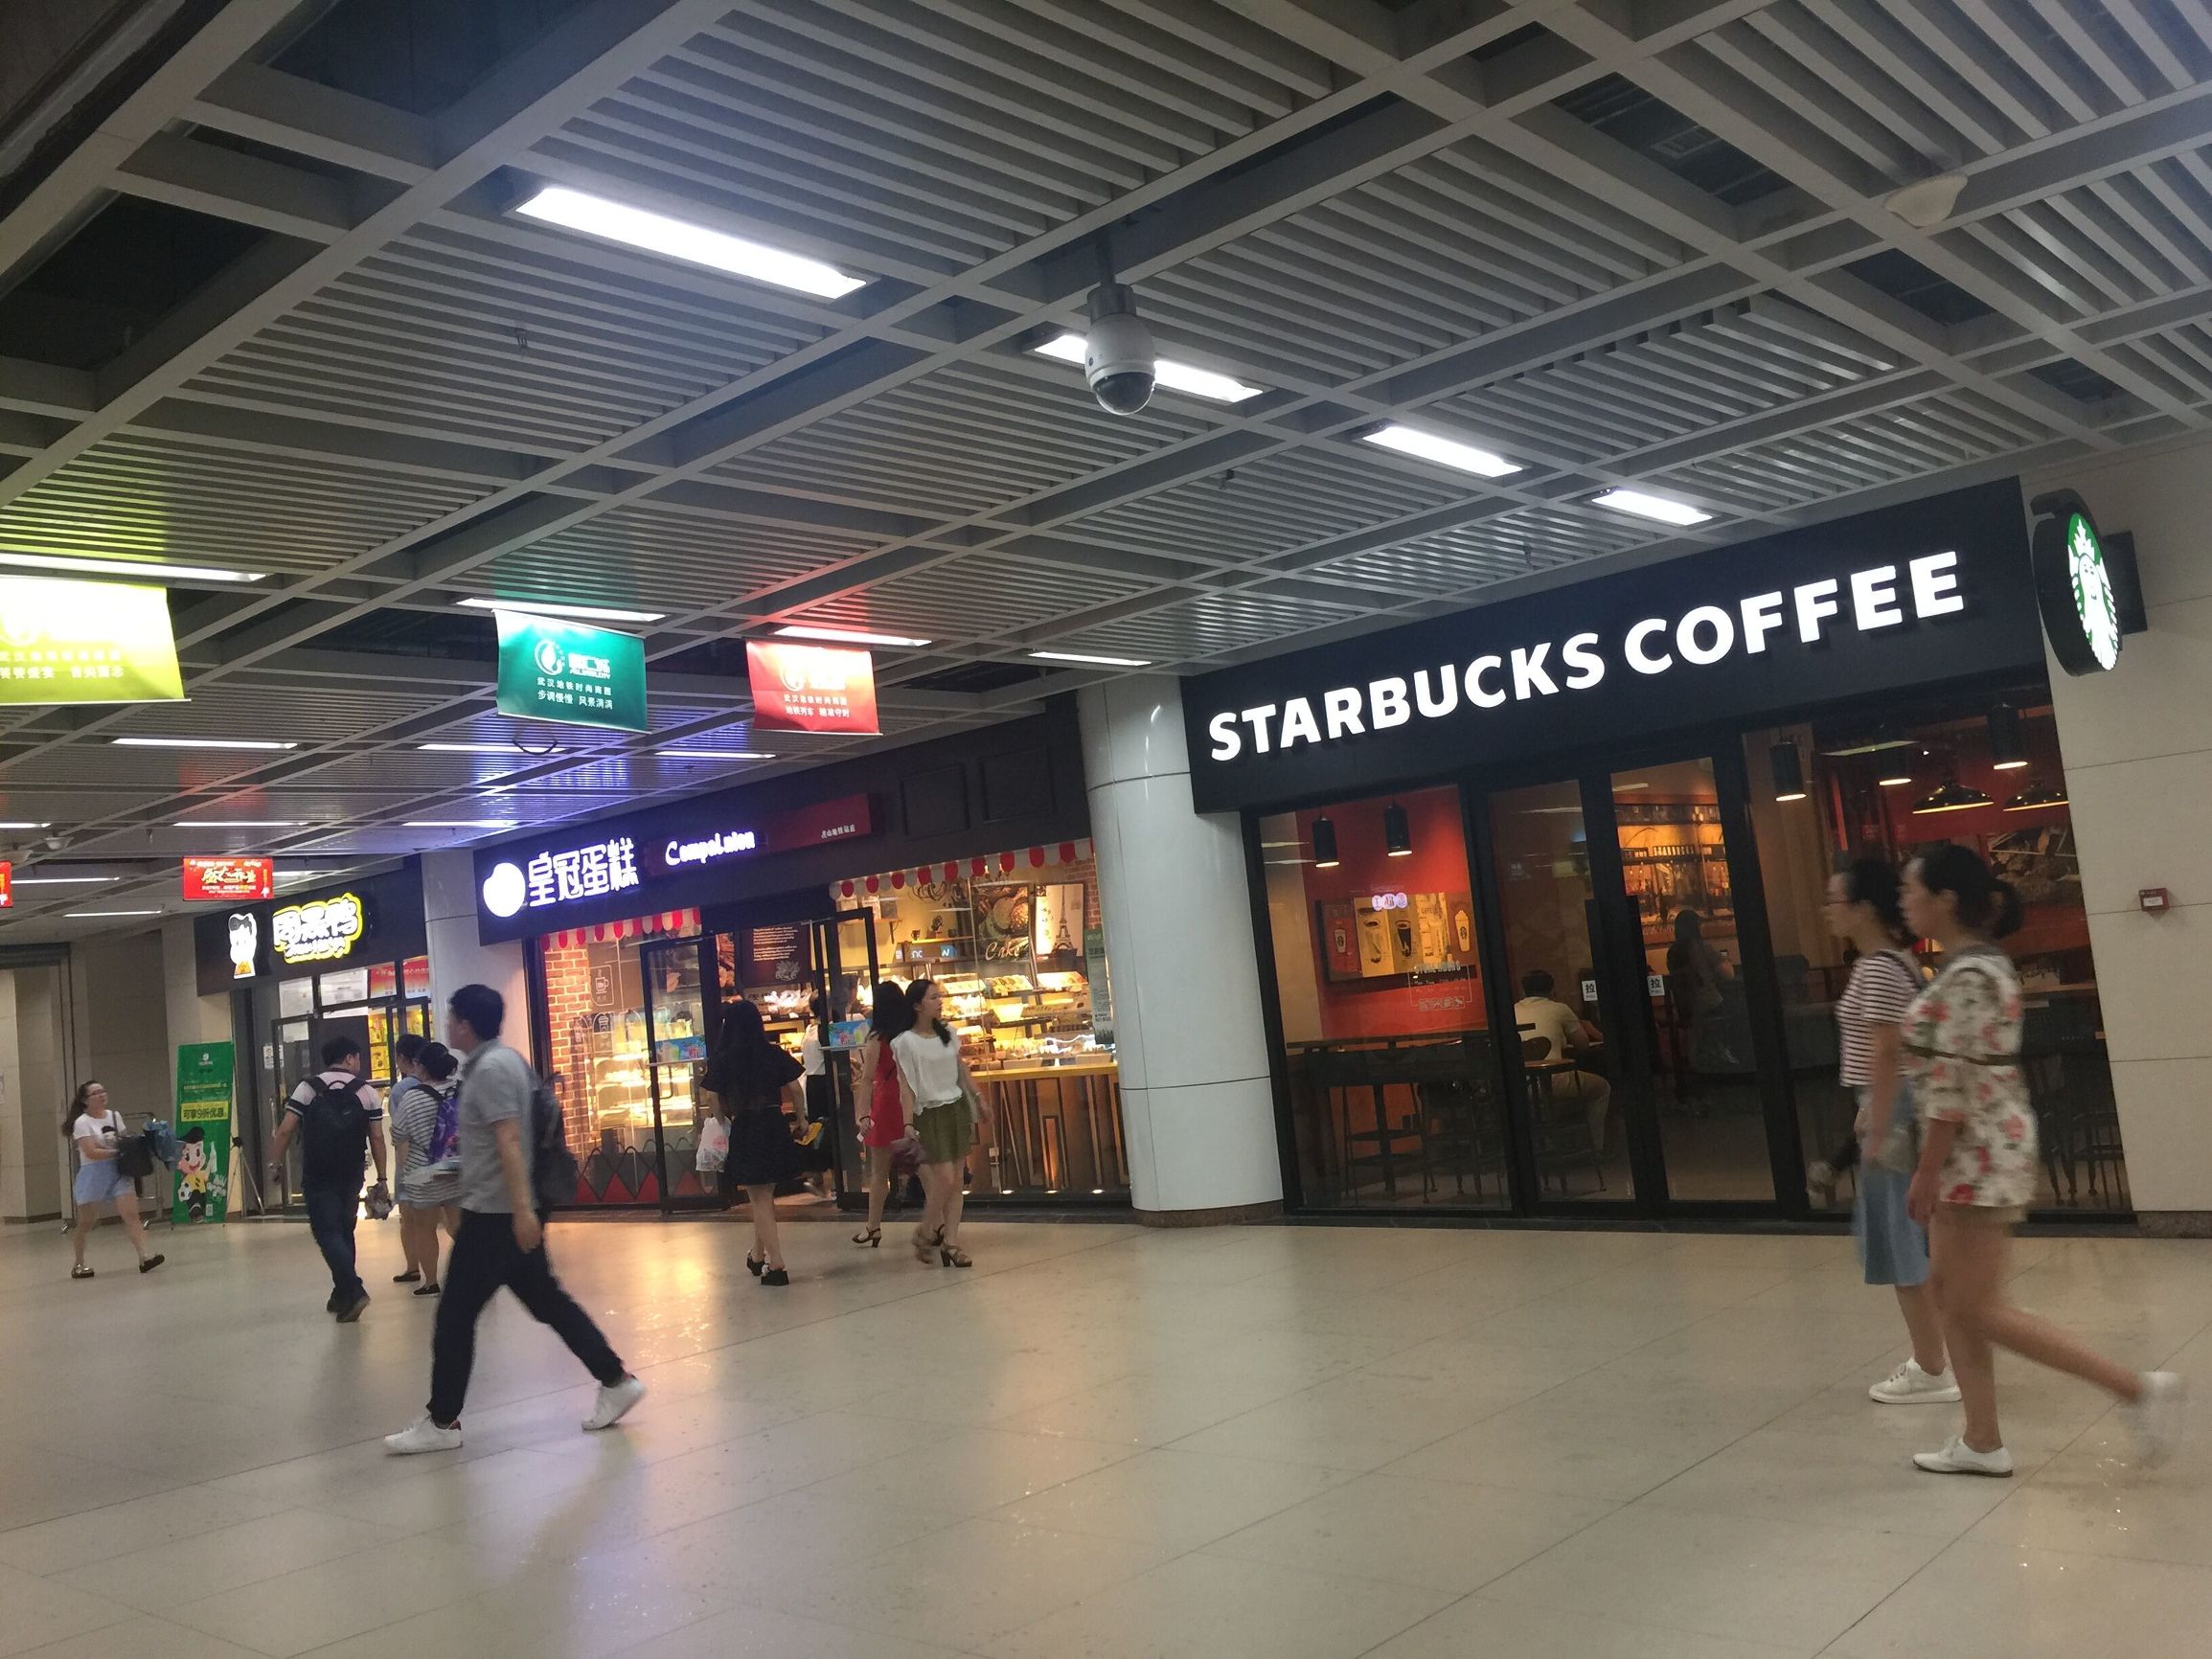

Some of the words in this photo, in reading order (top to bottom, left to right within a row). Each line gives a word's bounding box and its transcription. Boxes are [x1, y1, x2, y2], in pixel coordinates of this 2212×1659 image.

[1209, 632, 1607, 762] STARBUCKS
[1624, 551, 1966, 676] COFFEE
[537, 689, 574, 705] 步调慢慢
[527, 837, 640, 908] 皇冠蛋糕
[985, 942, 1019, 962] Cake
[1585, 983, 1596, 993] 拉
[1651, 978, 1661, 989] 拉
